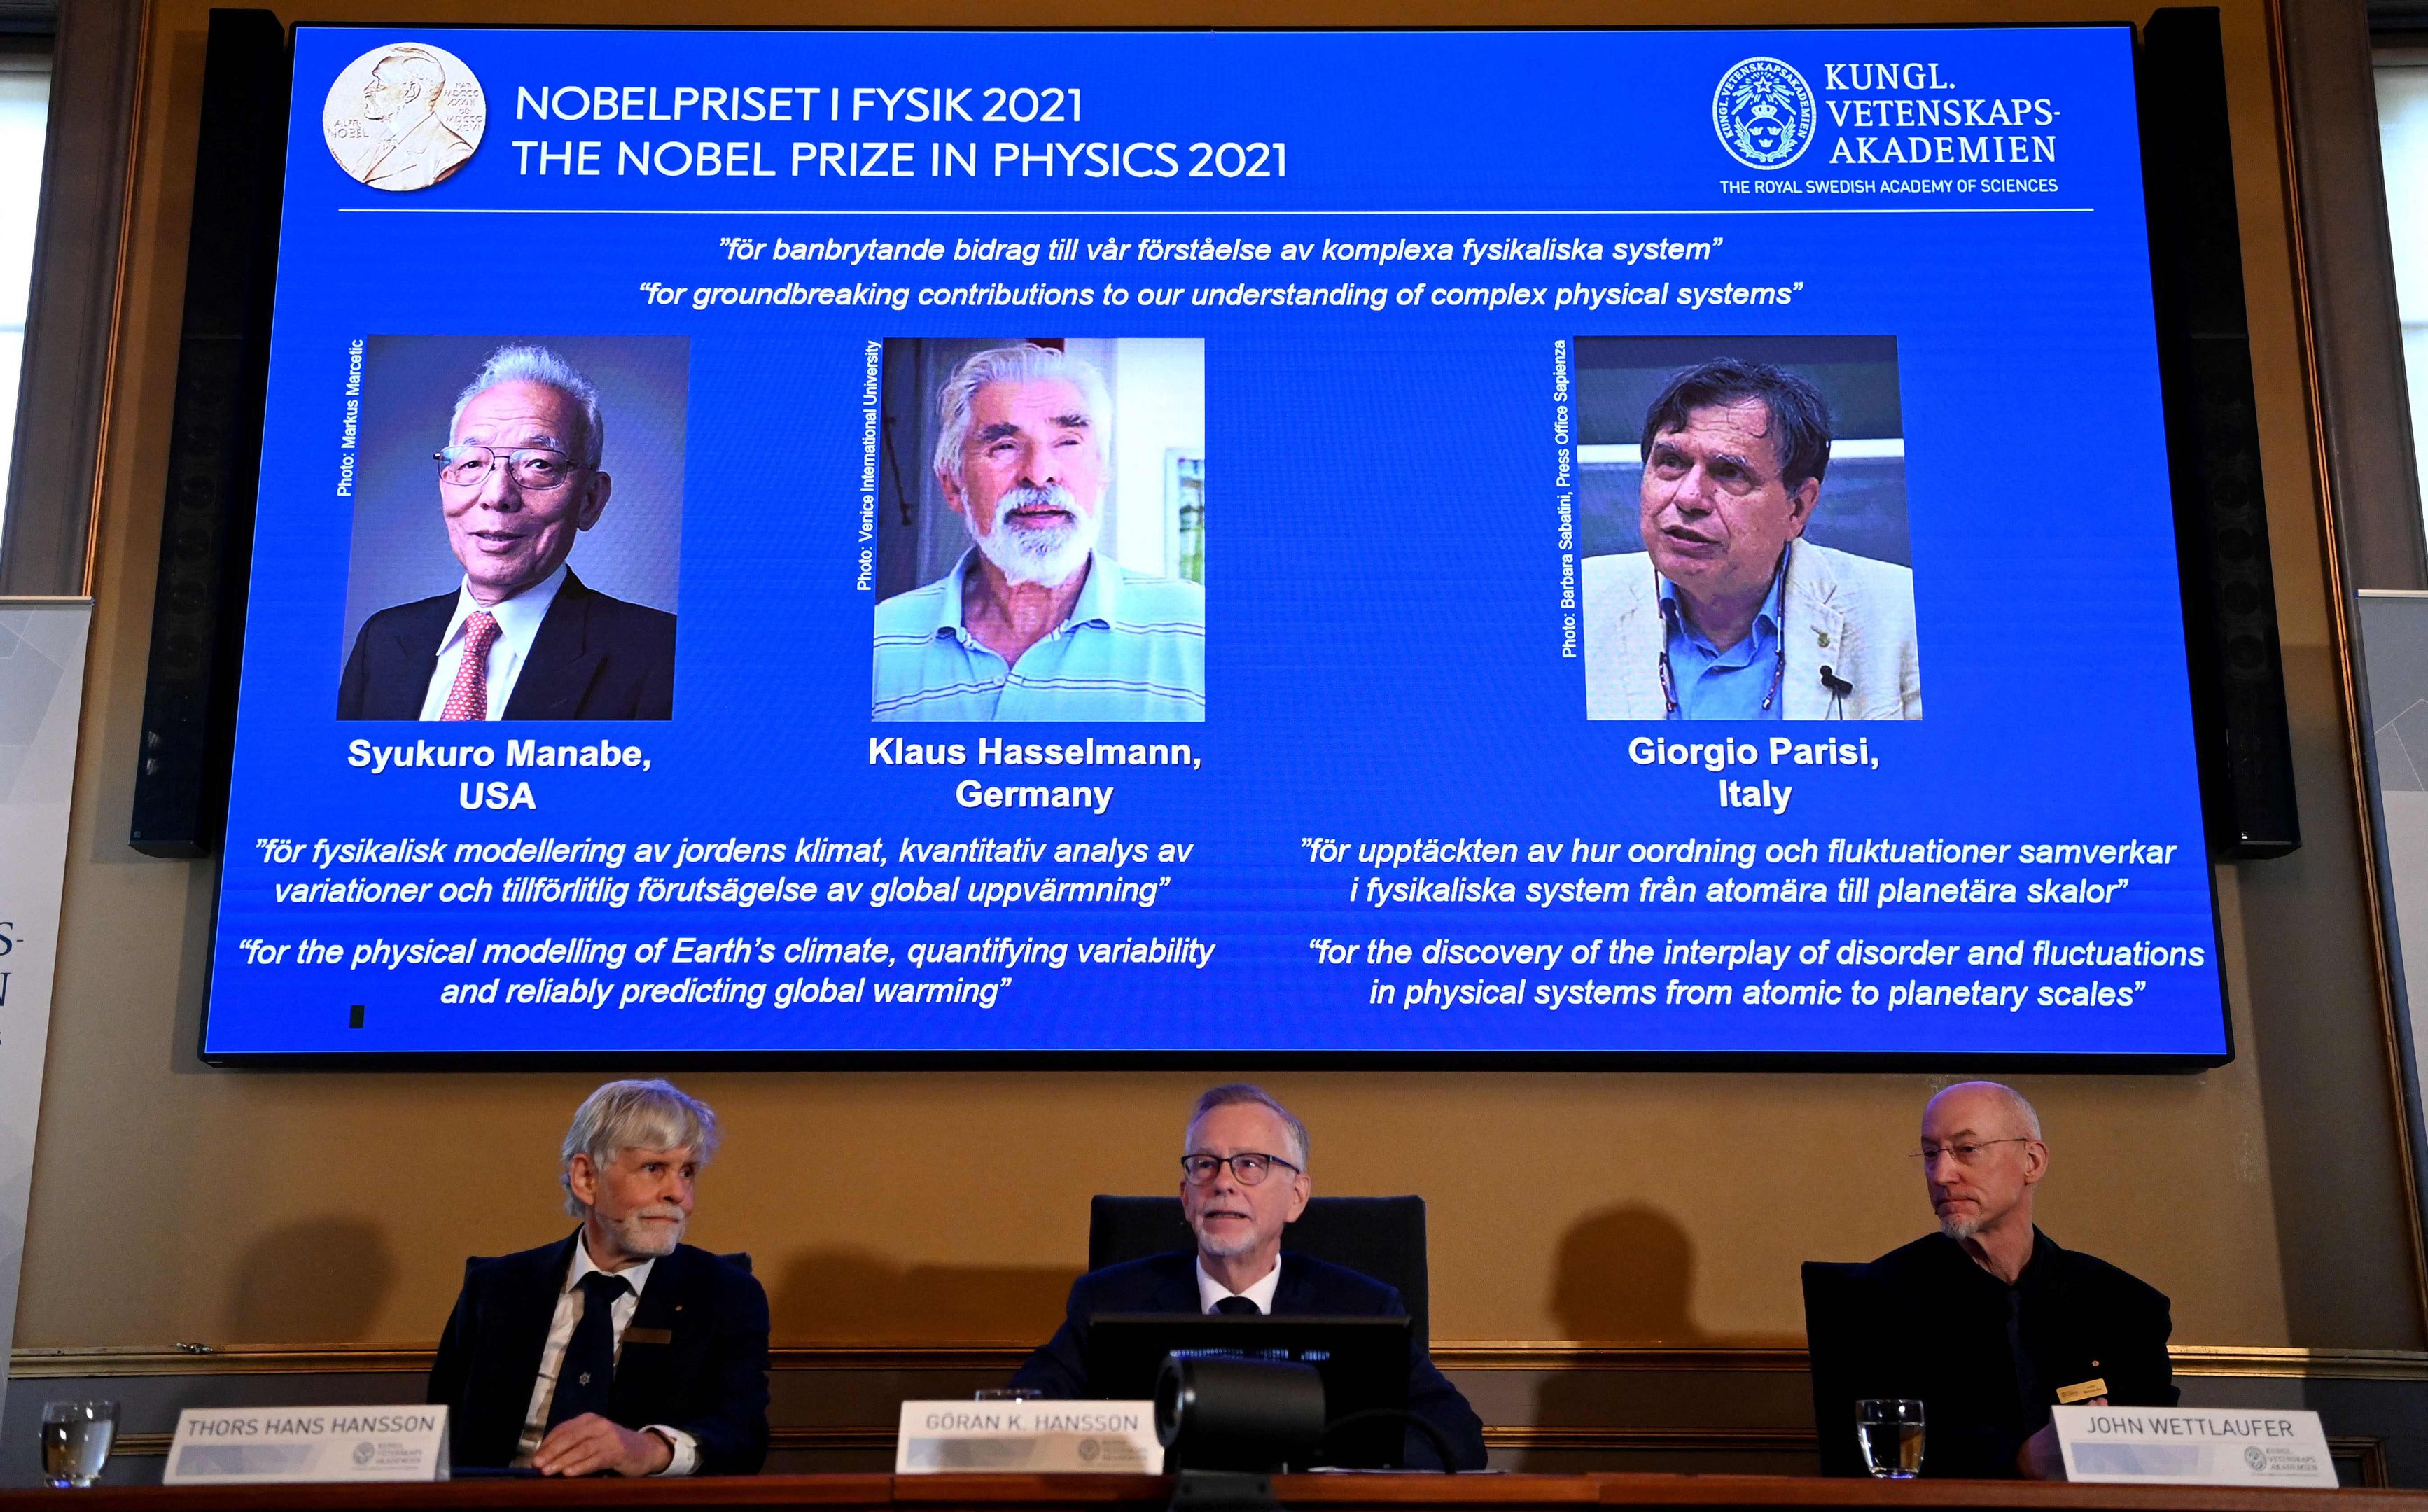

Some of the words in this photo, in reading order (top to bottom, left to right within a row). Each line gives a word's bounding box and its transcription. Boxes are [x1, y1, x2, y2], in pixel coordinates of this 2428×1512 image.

[1825, 63, 1955, 90] KUNGL.
[517, 86, 820, 121] NOBELPRISET
[832, 88, 838, 120] I
[853, 88, 972, 122] FYSIK
[983, 88, 1080, 122] 2021
[1721, 62, 1810, 139] VETENSKAPSAKADEMIEN
[1826, 99, 2061, 126] VETENSKAPS-
[1719, 97, 1734, 139] KUNGL.
[512, 141, 601, 175] THE
[618, 141, 776, 176] NOBEL
[793, 143, 914, 176] PRIZE
[933, 143, 975, 176] IN
[995, 143, 1178, 177] PHYSICS
[1189, 143, 1285, 177] 2021
[1829, 136, 2056, 163] AKADEMIEN
[1720, 181, 1750, 193] THE
[1755, 181, 1802, 193] ROYAL
[1806, 180, 1875, 192] SWEDISH
[1881, 180, 1952, 192] ACADEMY
[1958, 180, 1976, 192] OF
[1981, 178, 2058, 192] SCIENCES
[773, 238, 944, 265] banbrytande
[954, 239, 1040, 265] bidrag
[1049, 239, 1079, 260] till
[1087, 238, 1131, 260] vår
[1138, 238, 1271, 260] förståelse
[1281, 244, 1314, 260] av
[1322, 239, 1453, 265] komplexa
[1463, 238, 1603, 265] fysikaliska
[692, 283, 909, 310] groundbreaking
[919, 284, 1094, 305] contributions
[1103, 284, 1129, 305] to
[1138, 289, 1185, 305] our
[1192, 284, 1388, 311] understanding
[1397, 284, 1426, 305] of
[1432, 283, 1547, 310] complex
[1554, 283, 1669, 310] physical
[346, 340, 363, 396] Marcetic
[863, 341, 881, 405] University
[1553, 340, 1569, 402] Sapienza
[342, 400, 358, 448] Markus
[1555, 406, 1568, 444] Office
[860, 410, 877, 491] International
[1556, 449, 1570, 486] Press
[337, 454, 354, 496] Photo:
[859, 495, 874, 542] Venice
[1557, 492, 1572, 550] Sabatini,
[857, 547, 872, 590] Photo:
[1561, 554, 1575, 608] Barbara
[1563, 614, 1576, 657] Photo:
[348, 739, 494, 774] Syukuro
[507, 740, 650, 771] Manabe,
[870, 738, 965, 764] Klaus
[979, 738, 1200, 770] Hasselmann,
[1629, 737, 1757, 771] Giorgio
[1770, 738, 1878, 769] Parisi,
[461, 782, 536, 809] USA
[956, 780, 1113, 814] Germany
[1720, 780, 1792, 814] Italy
[312, 839, 447, 869] fysikalisk
[454, 838, 626, 868] modellering
[634, 844, 671, 862] av
[673, 838, 786, 868] jordens
[795, 838, 886, 867] klimat,
[899, 838, 1047, 862] kvantitativ
[1054, 838, 1148, 868] analys
[1158, 844, 1194, 862] av
[1359, 838, 1518, 868] upptäckten
[1528, 844, 1563, 862] av
[1572, 838, 1621, 862] hur
[1628, 838, 1756, 869] oordning
[1766, 839, 1817, 862] och
[1829, 839, 2011, 863] fluktuationer
[2019, 839, 2177, 864] samverkar
[277, 878, 433, 902] variationer
[439, 877, 492, 902] och
[502, 877, 629, 907] tillförlitlig
[638, 877, 817, 907] förutsägelse
[827, 883, 863, 901] av
[870, 877, 960, 907] global
[1351, 877, 1359, 901] i
[1367, 877, 1515, 907] fysikaliska
[1526, 878, 1629, 907] system
[1640, 876, 1696, 902] från
[1706, 878, 1827, 902] atomära
[1839, 878, 1869, 902] till
[1877, 878, 2016, 908] planetära
[297, 939, 344, 963] the
[351, 938, 477, 969] physical
[483, 938, 626, 969] modelling
[635, 938, 668, 962] of
[785, 937, 895, 967] climate,
[908, 937, 1068, 968] quantifying
[1078, 938, 1215, 968] variability
[1367, 939, 1412, 963] the
[1422, 939, 1563, 970] discovery
[1571, 939, 1603, 964] of
[1609, 939, 1654, 964] the
[1664, 939, 1791, 970] interplay
[1799, 939, 1830, 964] of
[1836, 939, 1960, 965] disorder
[1968, 940, 2024, 965] and
[2033, 940, 2204, 966] fluctuations
[441, 978, 500, 1003] and
[506, 978, 614, 1009] reliably
[619, 978, 767, 1009] predicting
[774, 978, 865, 1009] global
[1370, 979, 1395, 1004] in
[1404, 979, 1526, 1009] physical
[1534, 979, 1656, 1010] systems
[1666, 979, 1732, 1004] from
[1743, 979, 1842, 1004] atomic
[1852, 980, 1879, 1004] to
[1888, 980, 2028, 1011] planetary
[190, 1420, 258, 1435] THORS
[265, 1418, 323, 1434] HANS
[332, 1417, 434, 1432] HANSSON
[1008, 1415, 1026, 1431] K.
[1035, 1415, 1138, 1432] HANSSON
[2088, 1417, 2143, 1434] JOHN
[2149, 1418, 2294, 1436] WETTLAUFER
